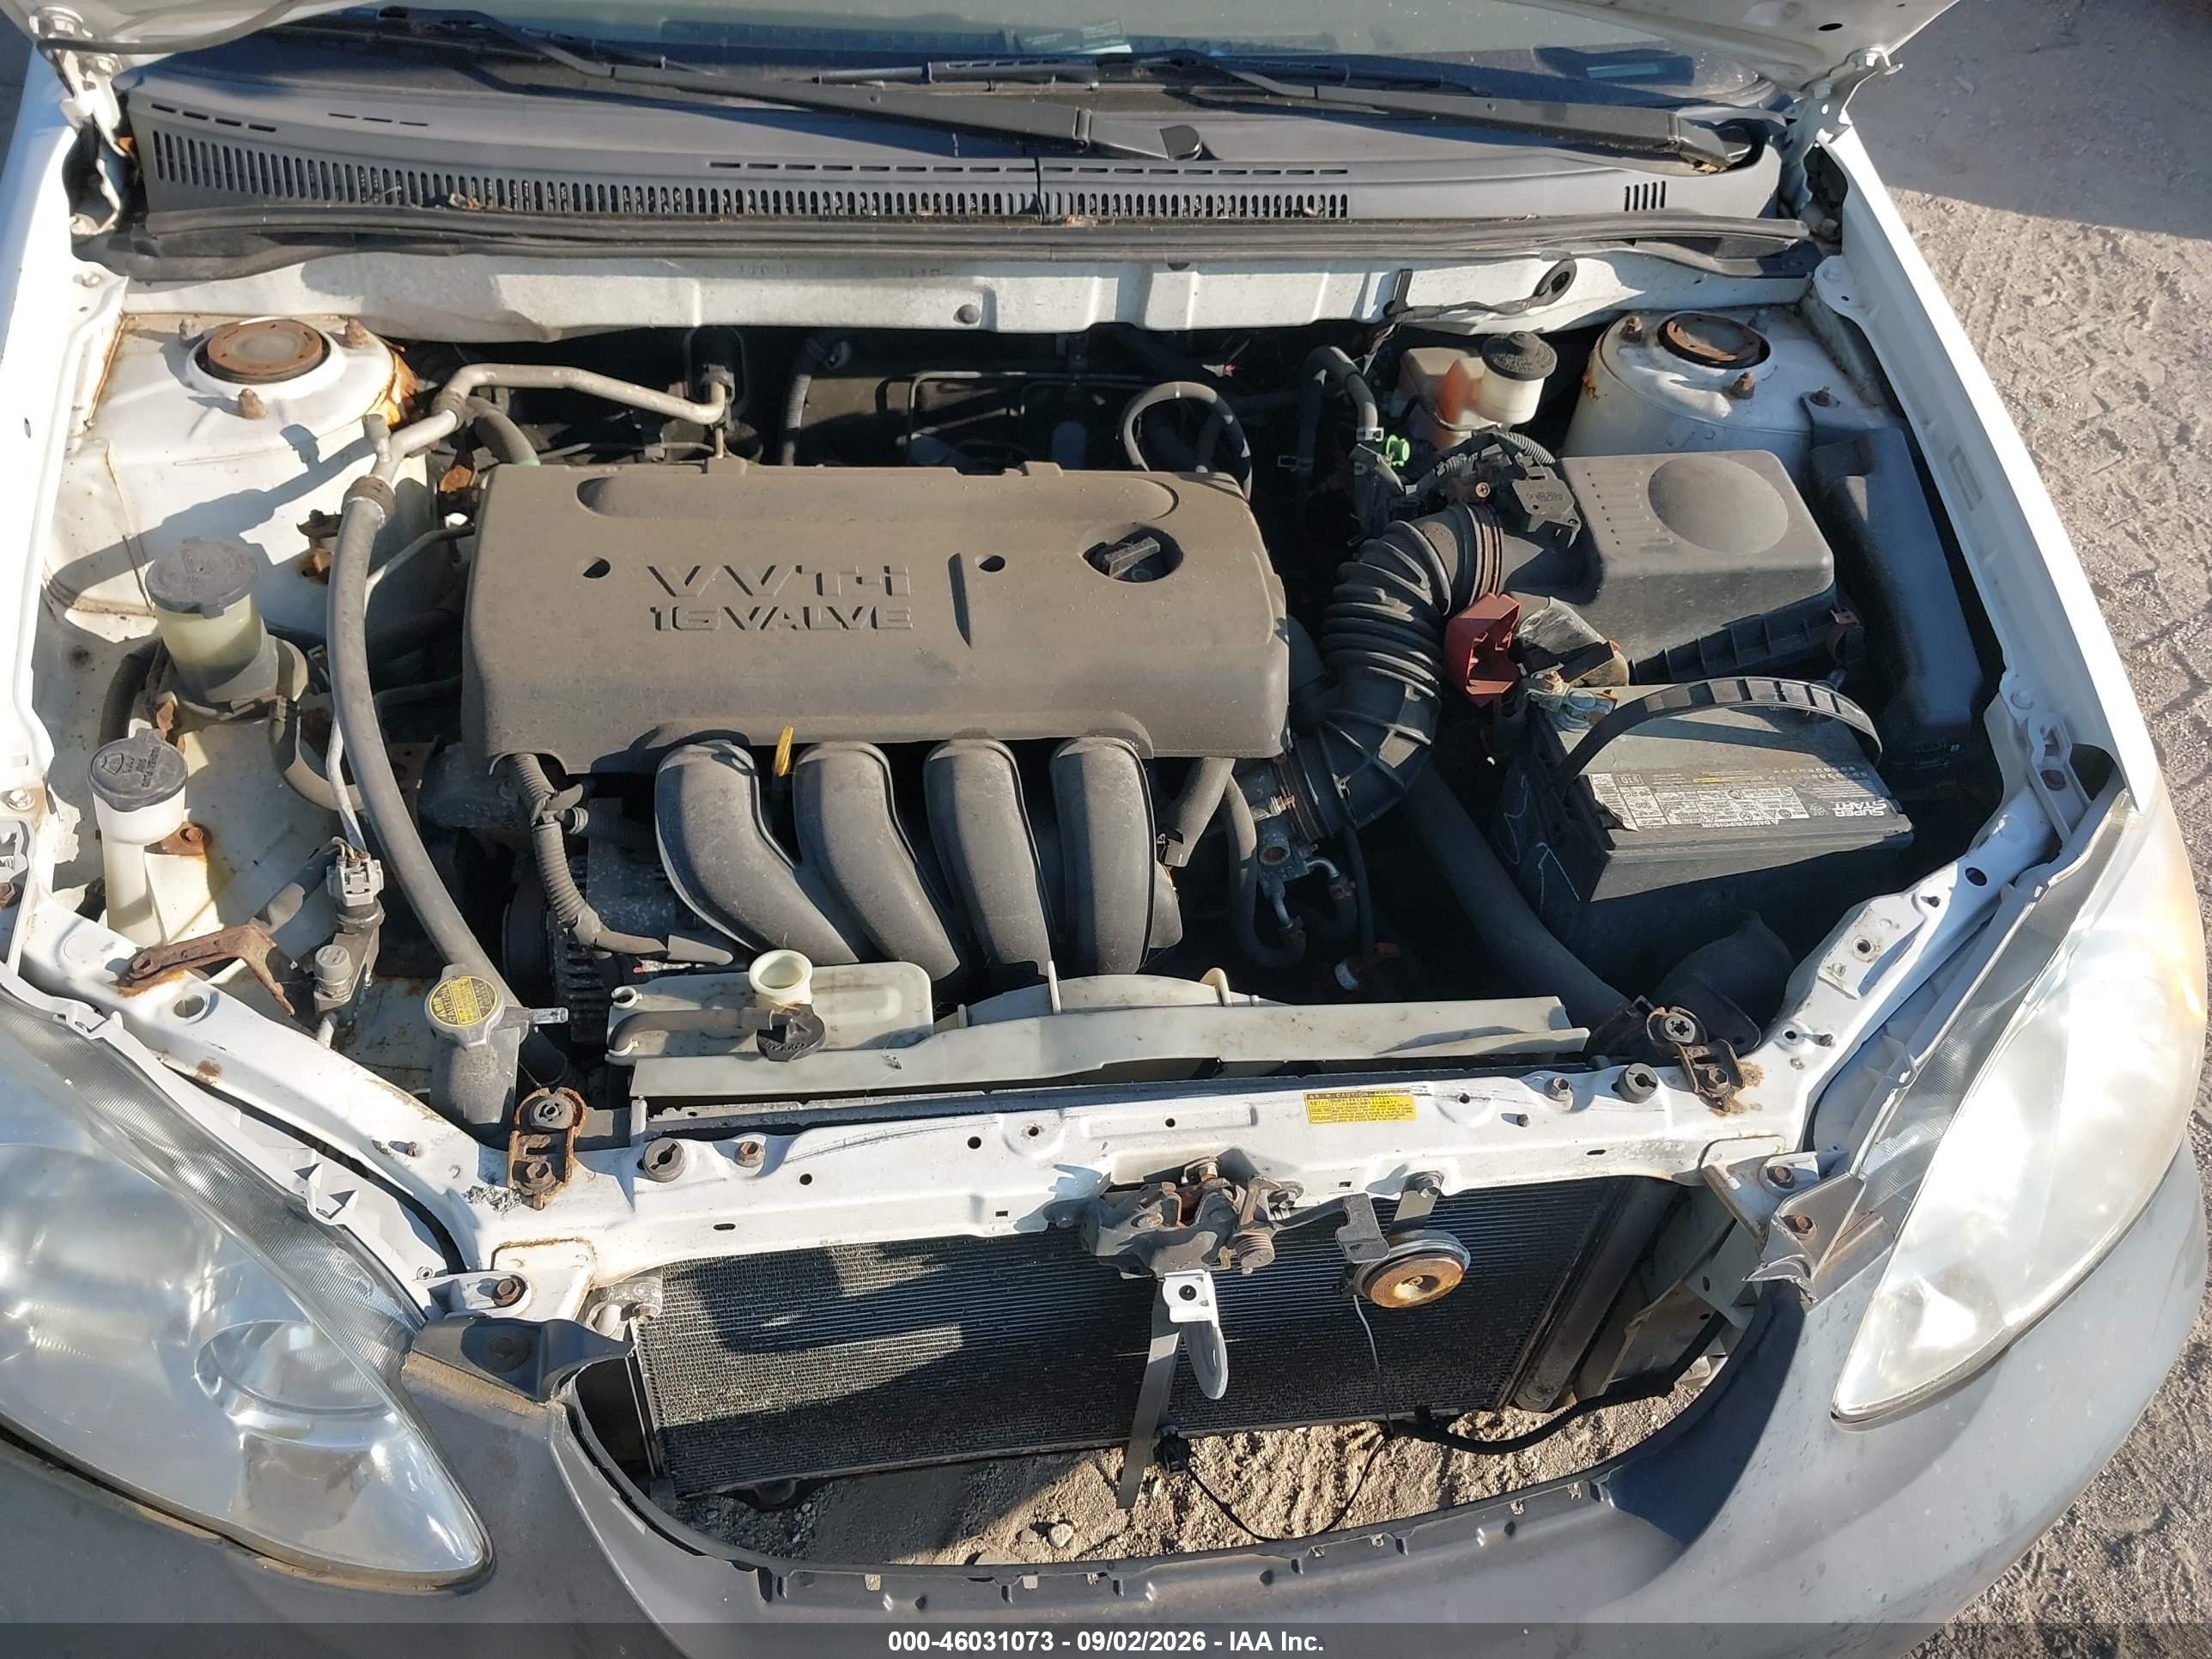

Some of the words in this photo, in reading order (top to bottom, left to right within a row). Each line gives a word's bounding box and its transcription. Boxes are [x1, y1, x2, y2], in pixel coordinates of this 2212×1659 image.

[1831, 799, 1887, 811] START
[1833, 807, 1886, 817] SUPER
[440, 987, 457, 1022] CAUTION
